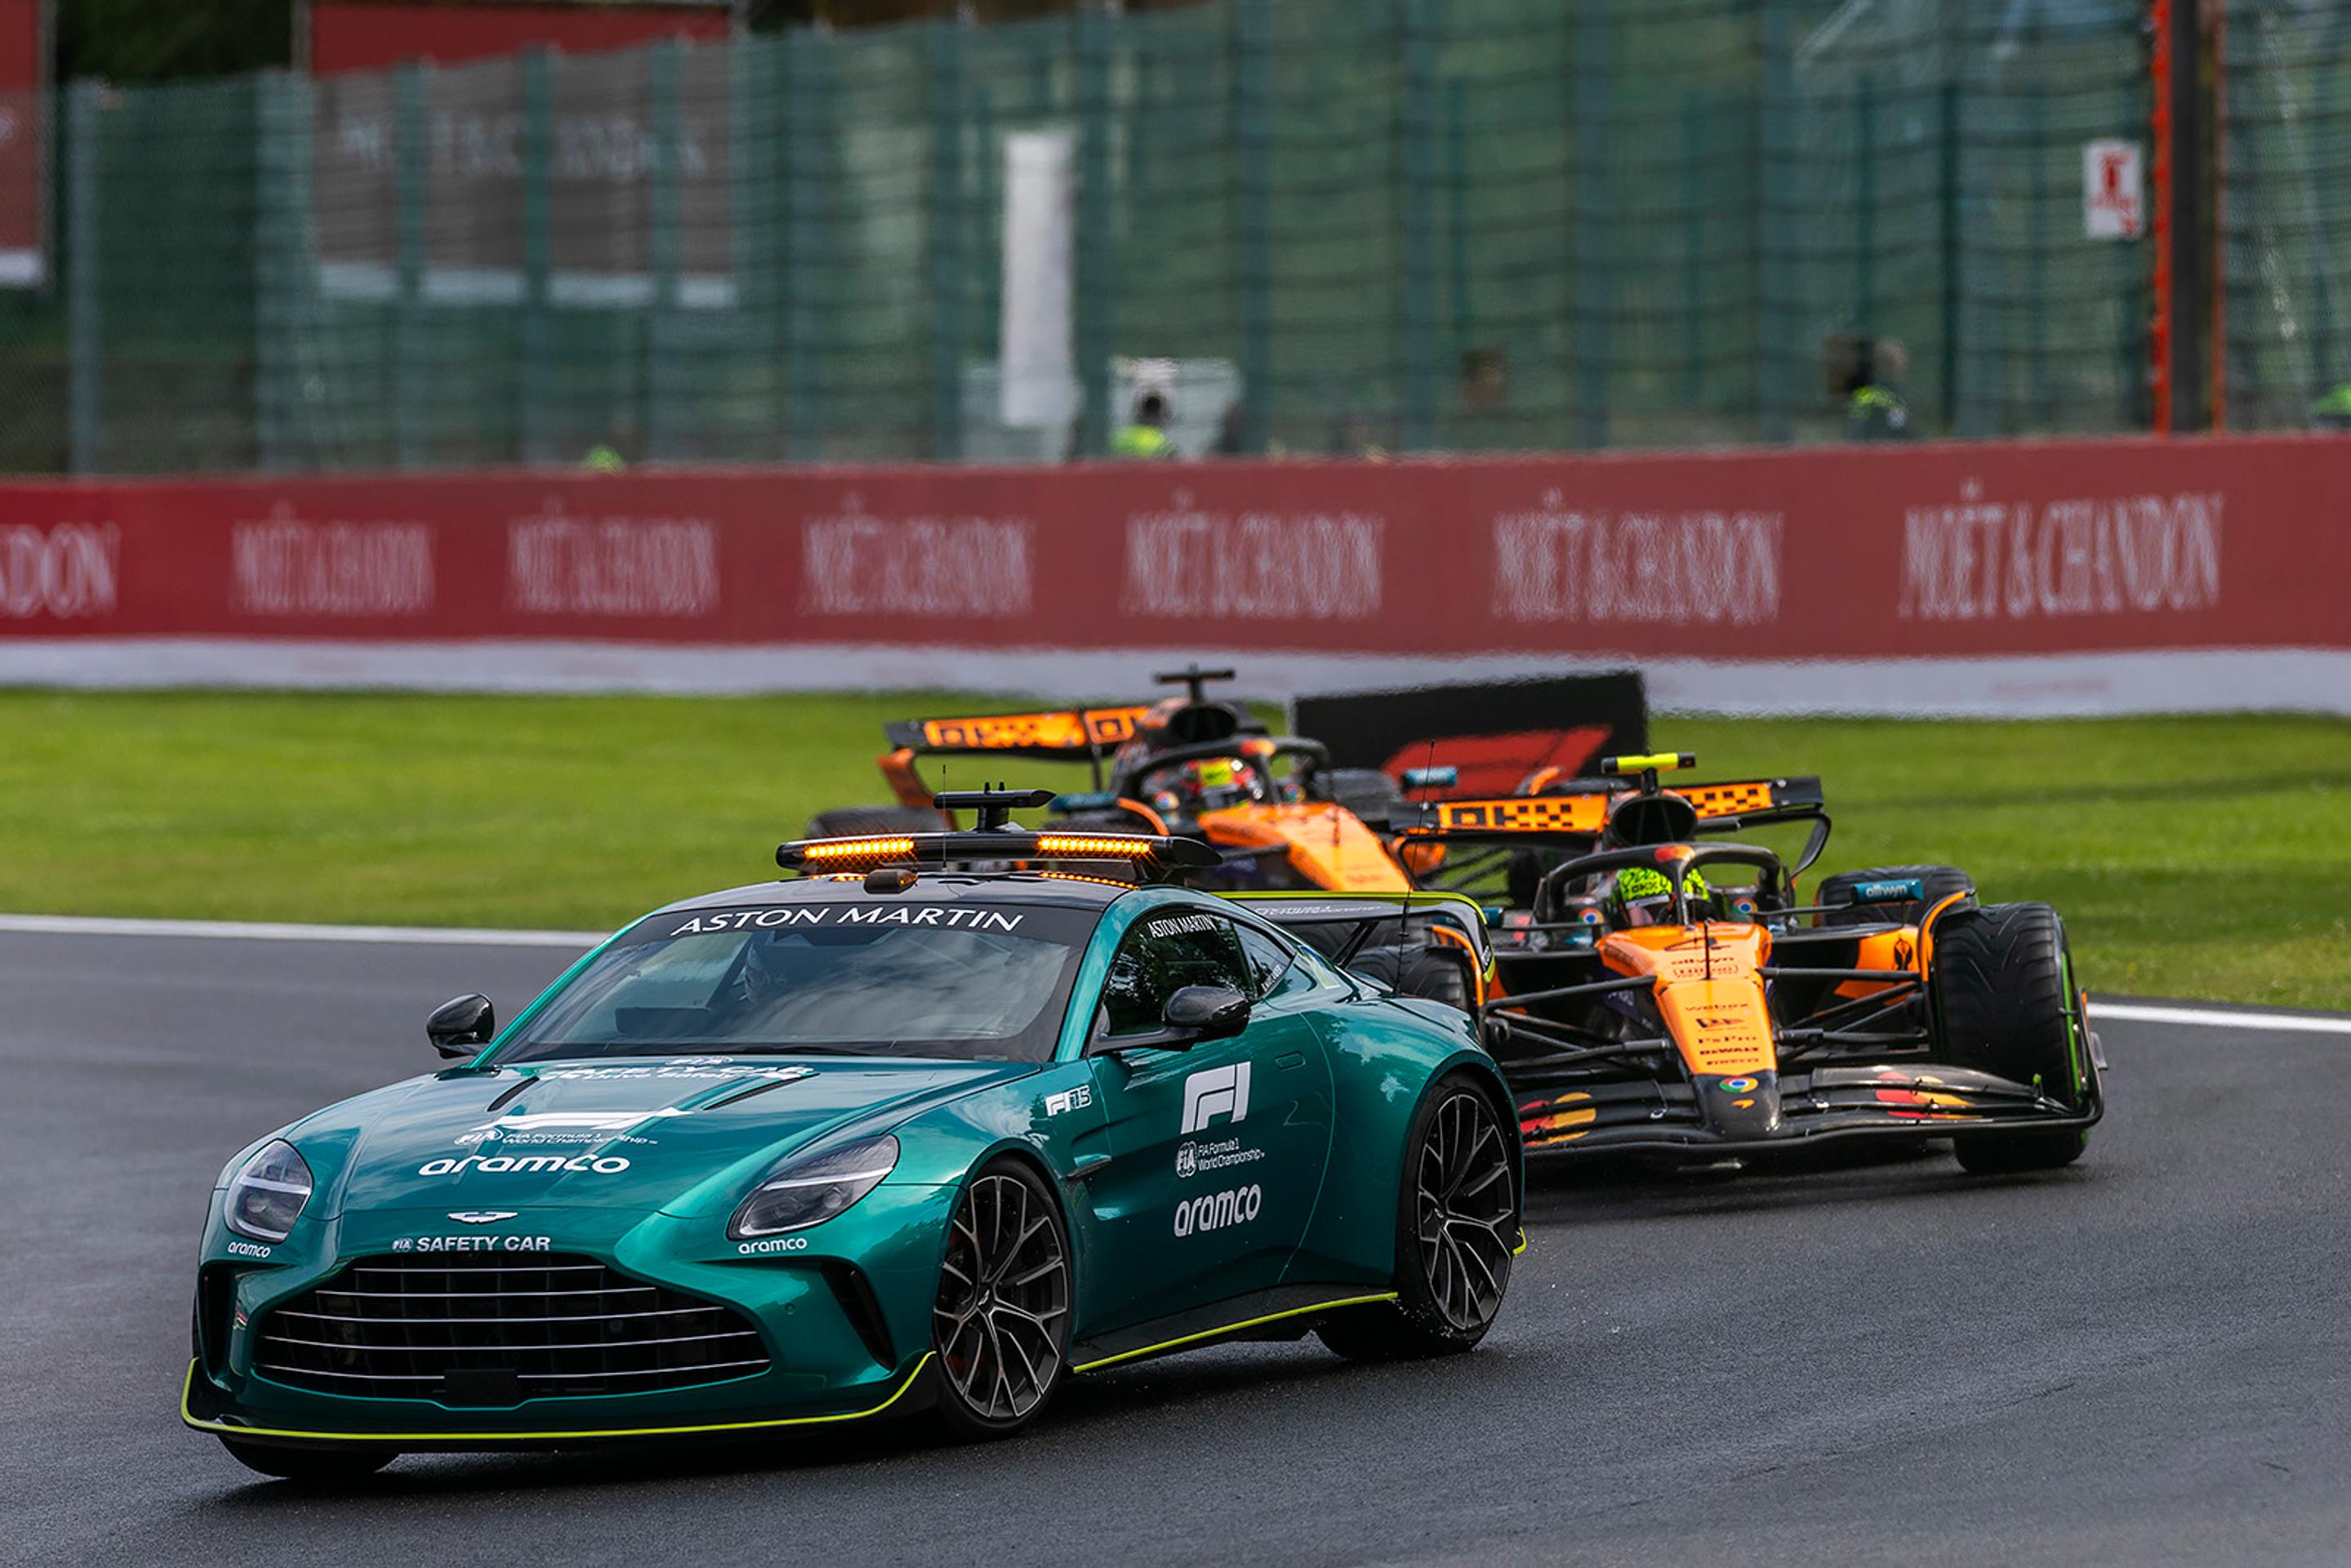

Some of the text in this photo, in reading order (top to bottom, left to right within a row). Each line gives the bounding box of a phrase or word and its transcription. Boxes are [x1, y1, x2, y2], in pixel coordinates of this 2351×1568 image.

[670, 906, 1024, 937] ASTON MARTIN
[1147, 913, 1217, 938] ASTON MARTIN
[419, 1154, 630, 1176] aramco
[1177, 1144, 1196, 1174] FIA
[1174, 1184, 1262, 1237] aramco
[227, 1241, 272, 1258] aramco
[416, 1236, 499, 1252] SAFETY
[504, 1236, 550, 1251] CAR
[737, 1237, 808, 1254] aramco
